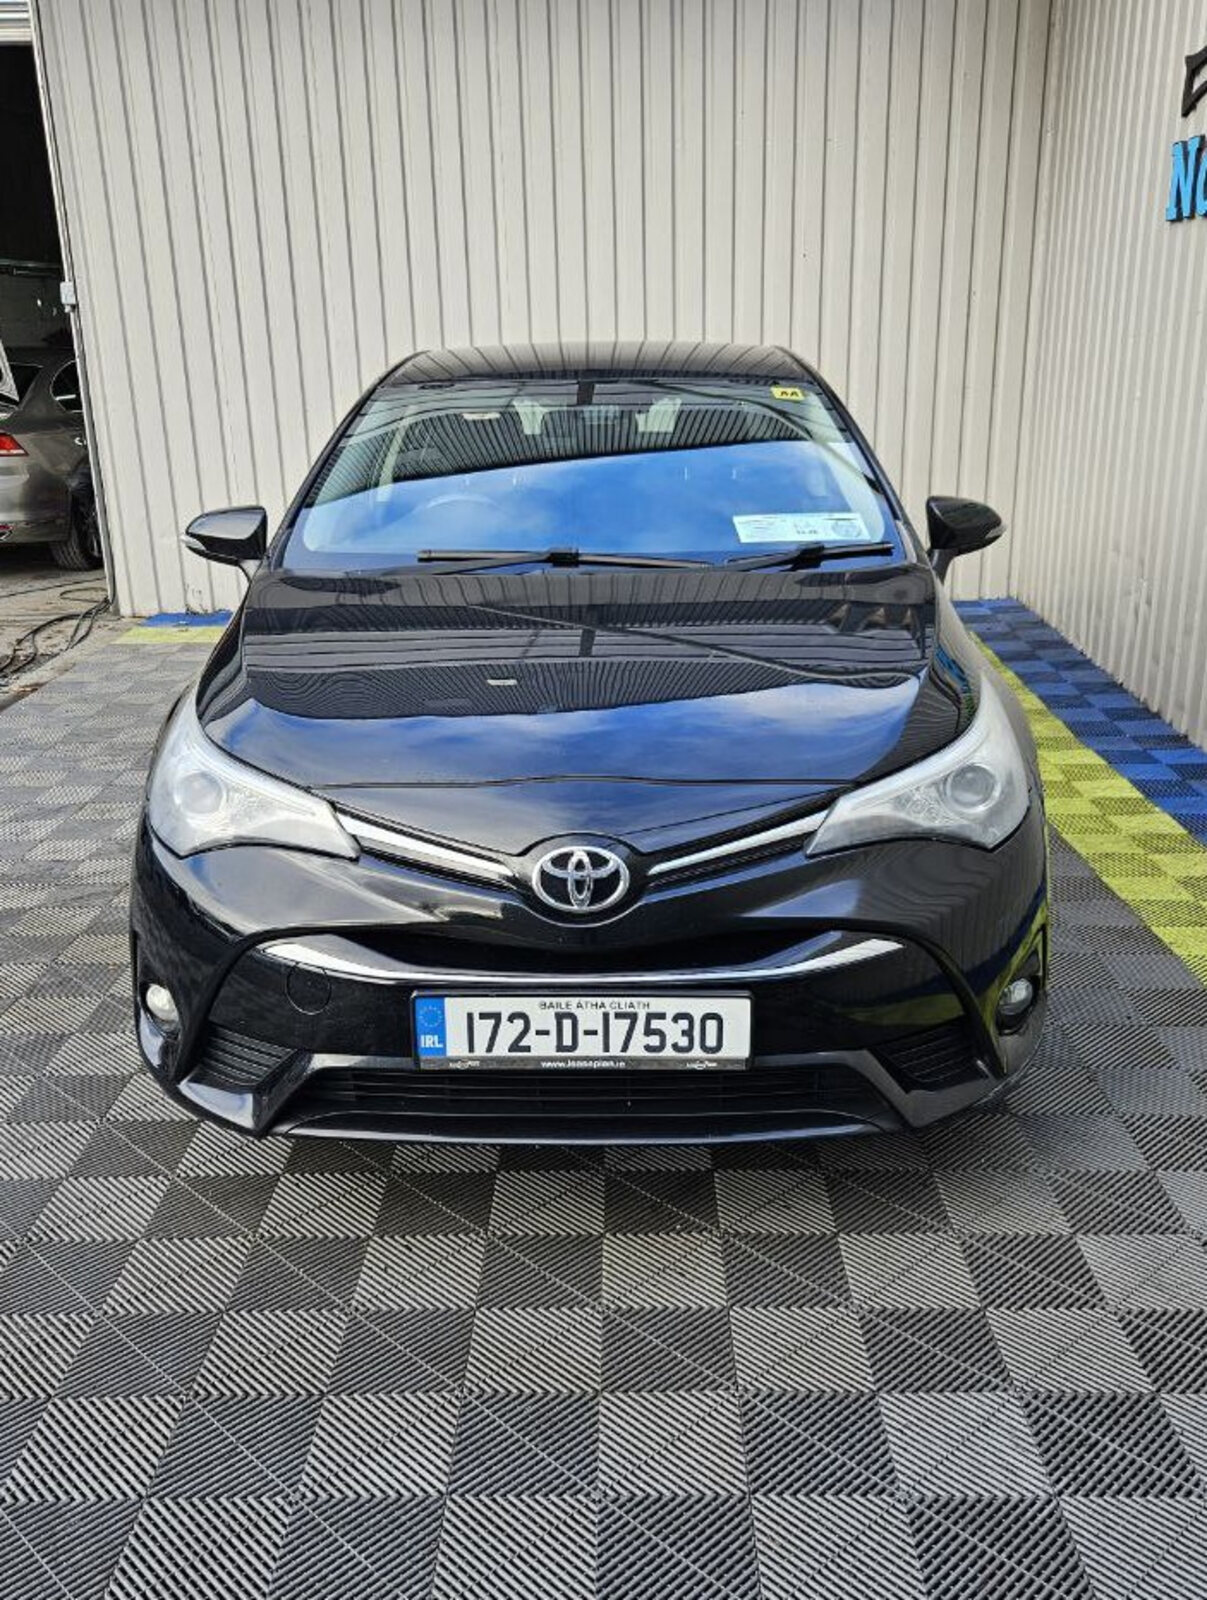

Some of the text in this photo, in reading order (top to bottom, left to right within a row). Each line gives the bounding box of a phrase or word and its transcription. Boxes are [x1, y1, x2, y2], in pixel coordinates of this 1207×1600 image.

[539, 1001, 572, 1010] BAILE
[609, 1001, 650, 1010] CLIATH
[466, 1012, 723, 1054] 172-D-17530
[421, 1034, 443, 1048] IRL
